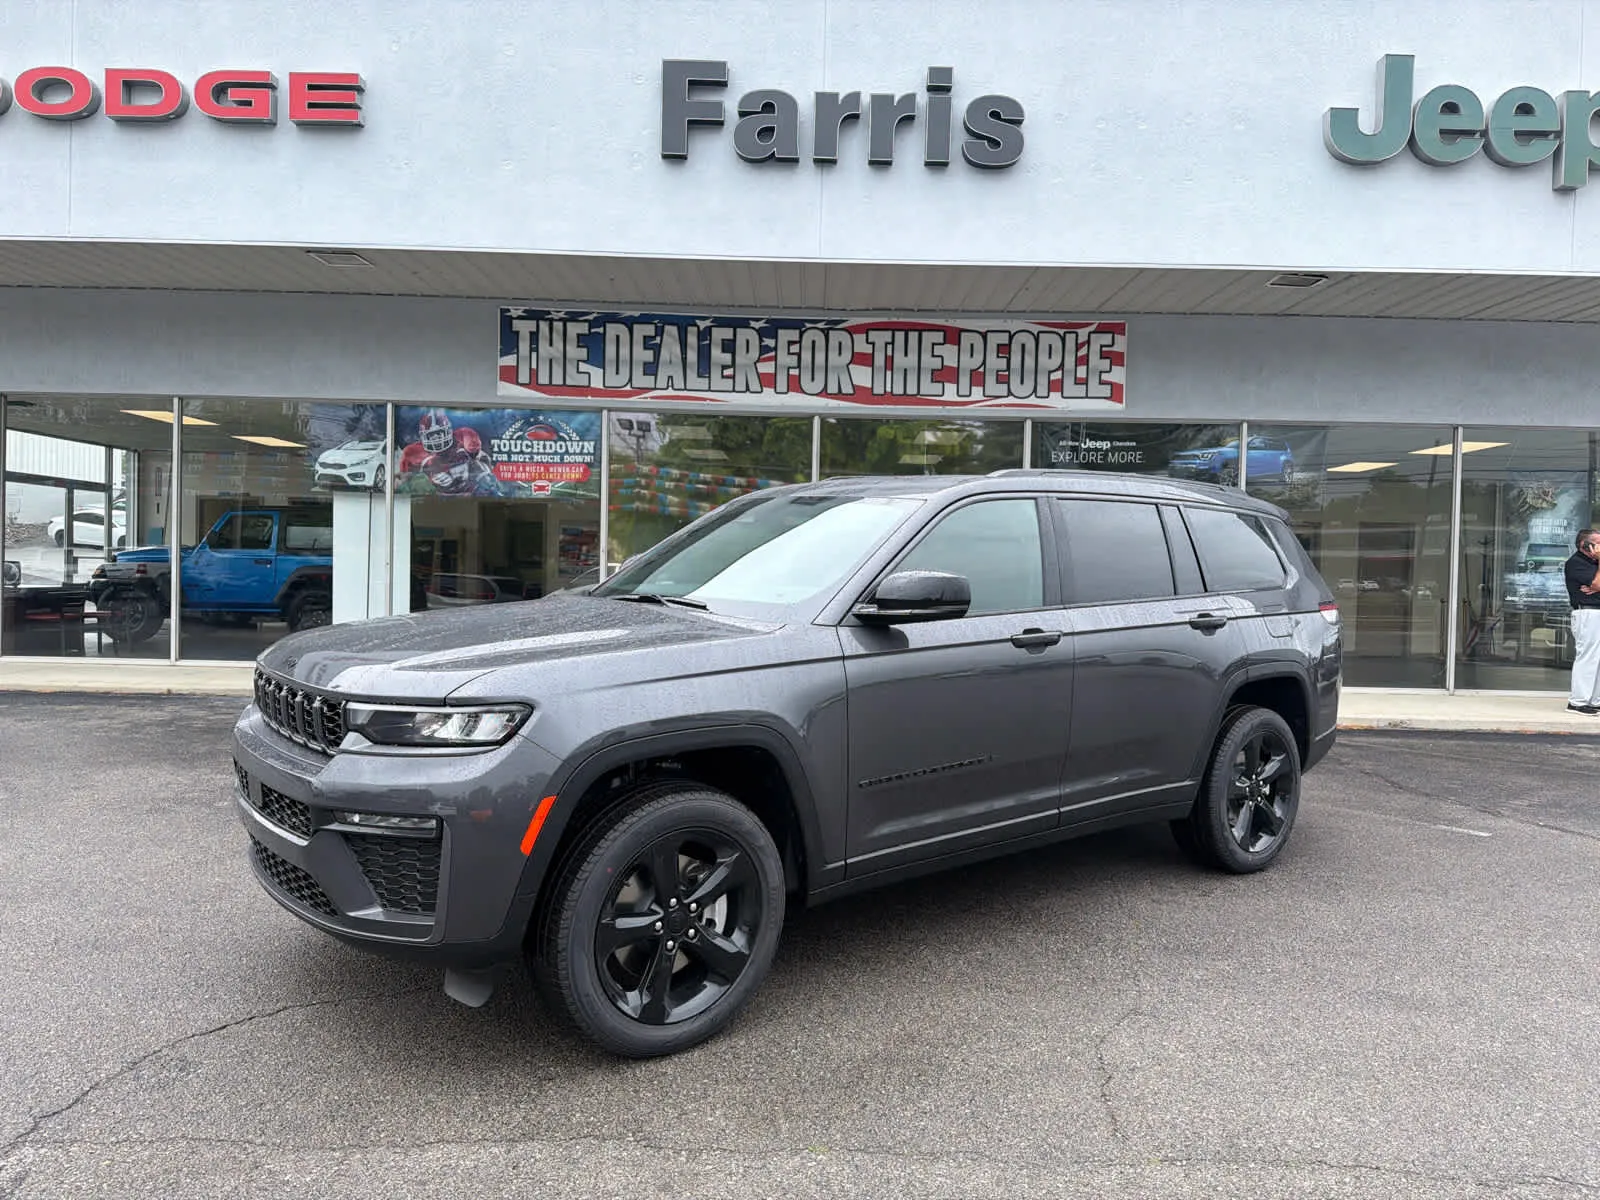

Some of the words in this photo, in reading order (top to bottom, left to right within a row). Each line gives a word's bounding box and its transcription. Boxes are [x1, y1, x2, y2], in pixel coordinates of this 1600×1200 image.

[0, 66, 365, 127] ODGE
[661, 58, 1025, 168] Farris
[512, 318, 591, 387] THE
[602, 320, 763, 394] DEALER
[775, 326, 855, 396] FOR
[866, 328, 945, 397] THE
[956, 328, 1115, 399] PEOPLE
[491, 439, 595, 454] TOUCHDOWN
[1081, 438, 1111, 450] Jeep
[492, 453, 508, 462] FOR
[511, 454, 530, 462] NOT
[533, 454, 560, 463] MUCH
[564, 455, 594, 463] DOWN!
[1051, 451, 1105, 463] EXPLORE
[1108, 451, 1144, 464] MORE
